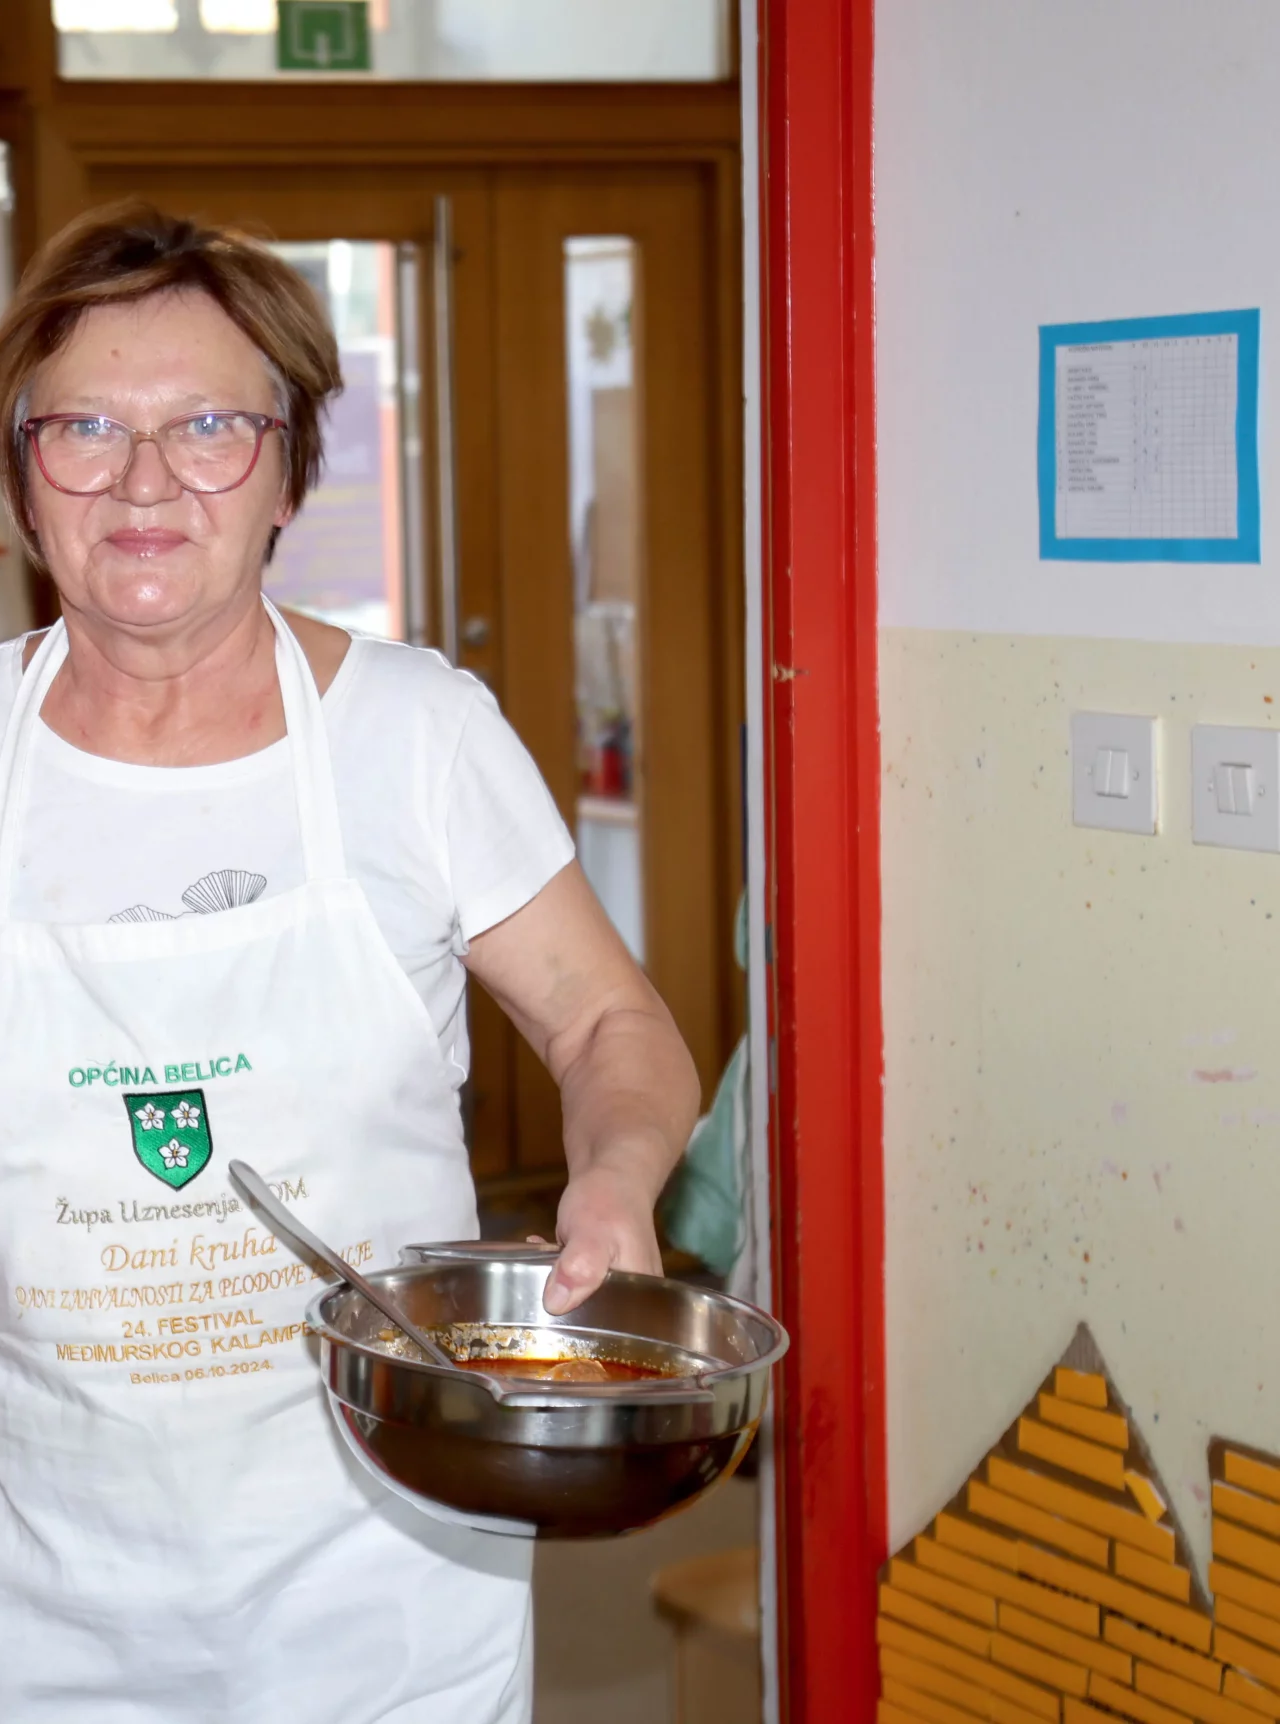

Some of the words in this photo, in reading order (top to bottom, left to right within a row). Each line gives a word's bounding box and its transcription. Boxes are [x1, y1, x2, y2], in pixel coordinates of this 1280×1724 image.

[68, 1060, 158, 1088] OPĆINA
[164, 1053, 253, 1084] BELICA
[55, 1196, 114, 1233] Župa
[118, 1193, 244, 1224] Uznesenja
[100, 1240, 178, 1272] Dani
[190, 1227, 278, 1271] kruha
[60, 1281, 183, 1312] ZAHVALNOSTI
[188, 1280, 215, 1304] ZA
[218, 1263, 307, 1298] PLODOVE
[121, 1320, 152, 1339] 24.
[157, 1308, 263, 1336] FESTIVAL
[210, 1320, 317, 1355] KALAMPE
[129, 1371, 180, 1384] Belica
[184, 1359, 274, 1382] 06.10.2024.
